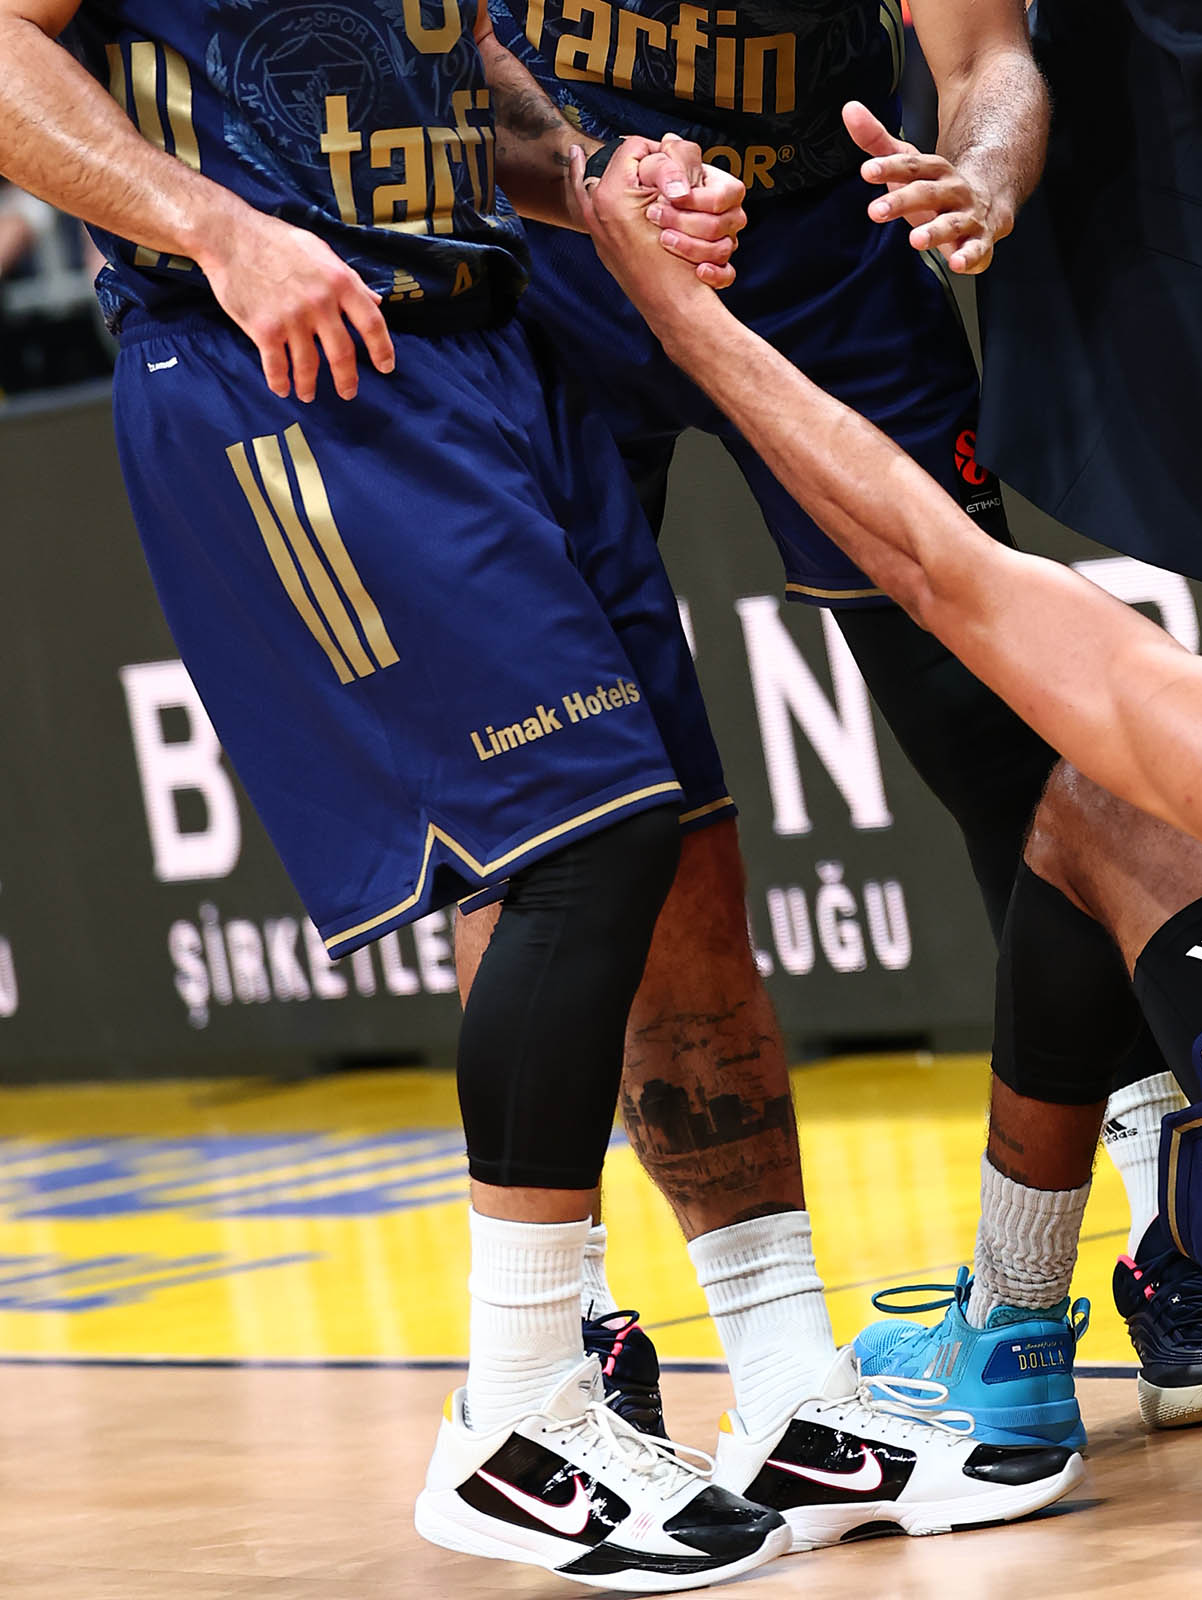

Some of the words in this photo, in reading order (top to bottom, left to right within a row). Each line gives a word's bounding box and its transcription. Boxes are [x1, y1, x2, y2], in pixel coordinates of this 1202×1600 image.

[320, 89, 492, 234] tarfi
[470, 704, 563, 761] Limak
[562, 677, 641, 723] Hotels
[168, 899, 458, 1029] ŞİRKELE
